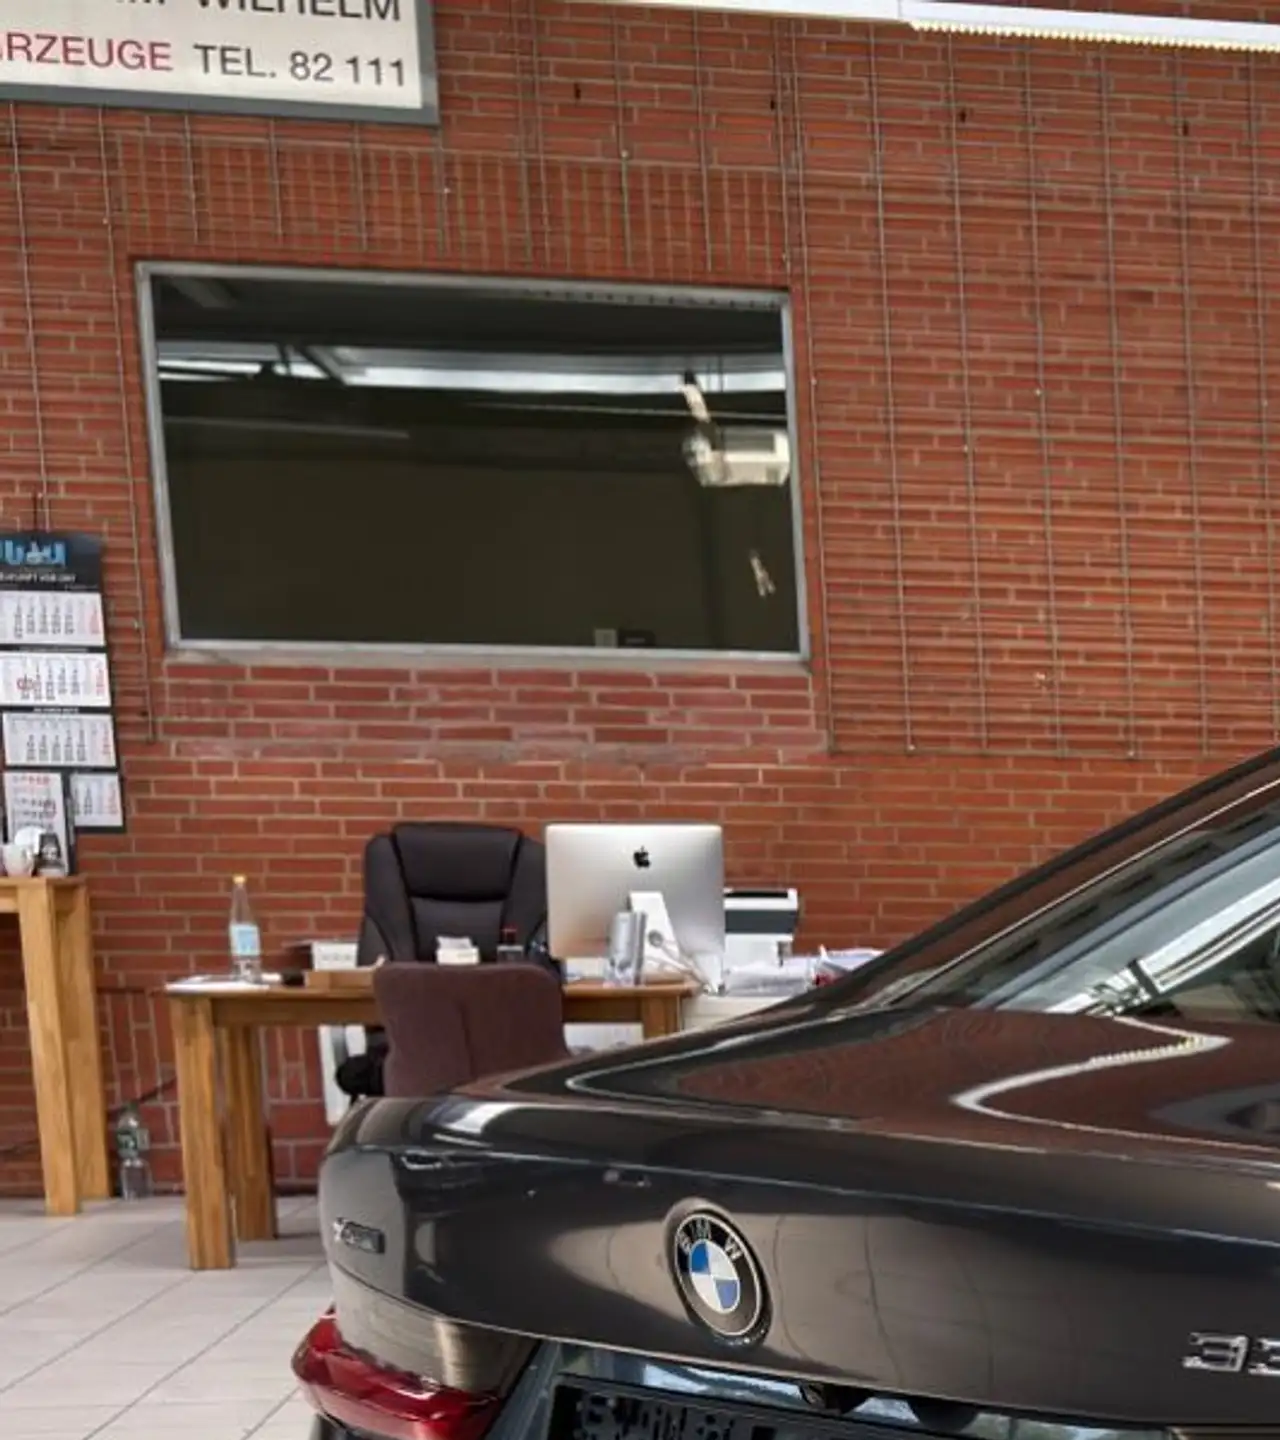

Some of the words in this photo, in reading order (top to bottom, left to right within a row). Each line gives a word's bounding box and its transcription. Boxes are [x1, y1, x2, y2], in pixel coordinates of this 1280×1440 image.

[0, 33, 173, 71] RZEUGE
[194, 44, 277, 78] TEL.
[290, 52, 334, 81] 82
[345, 57, 404, 86] 111
